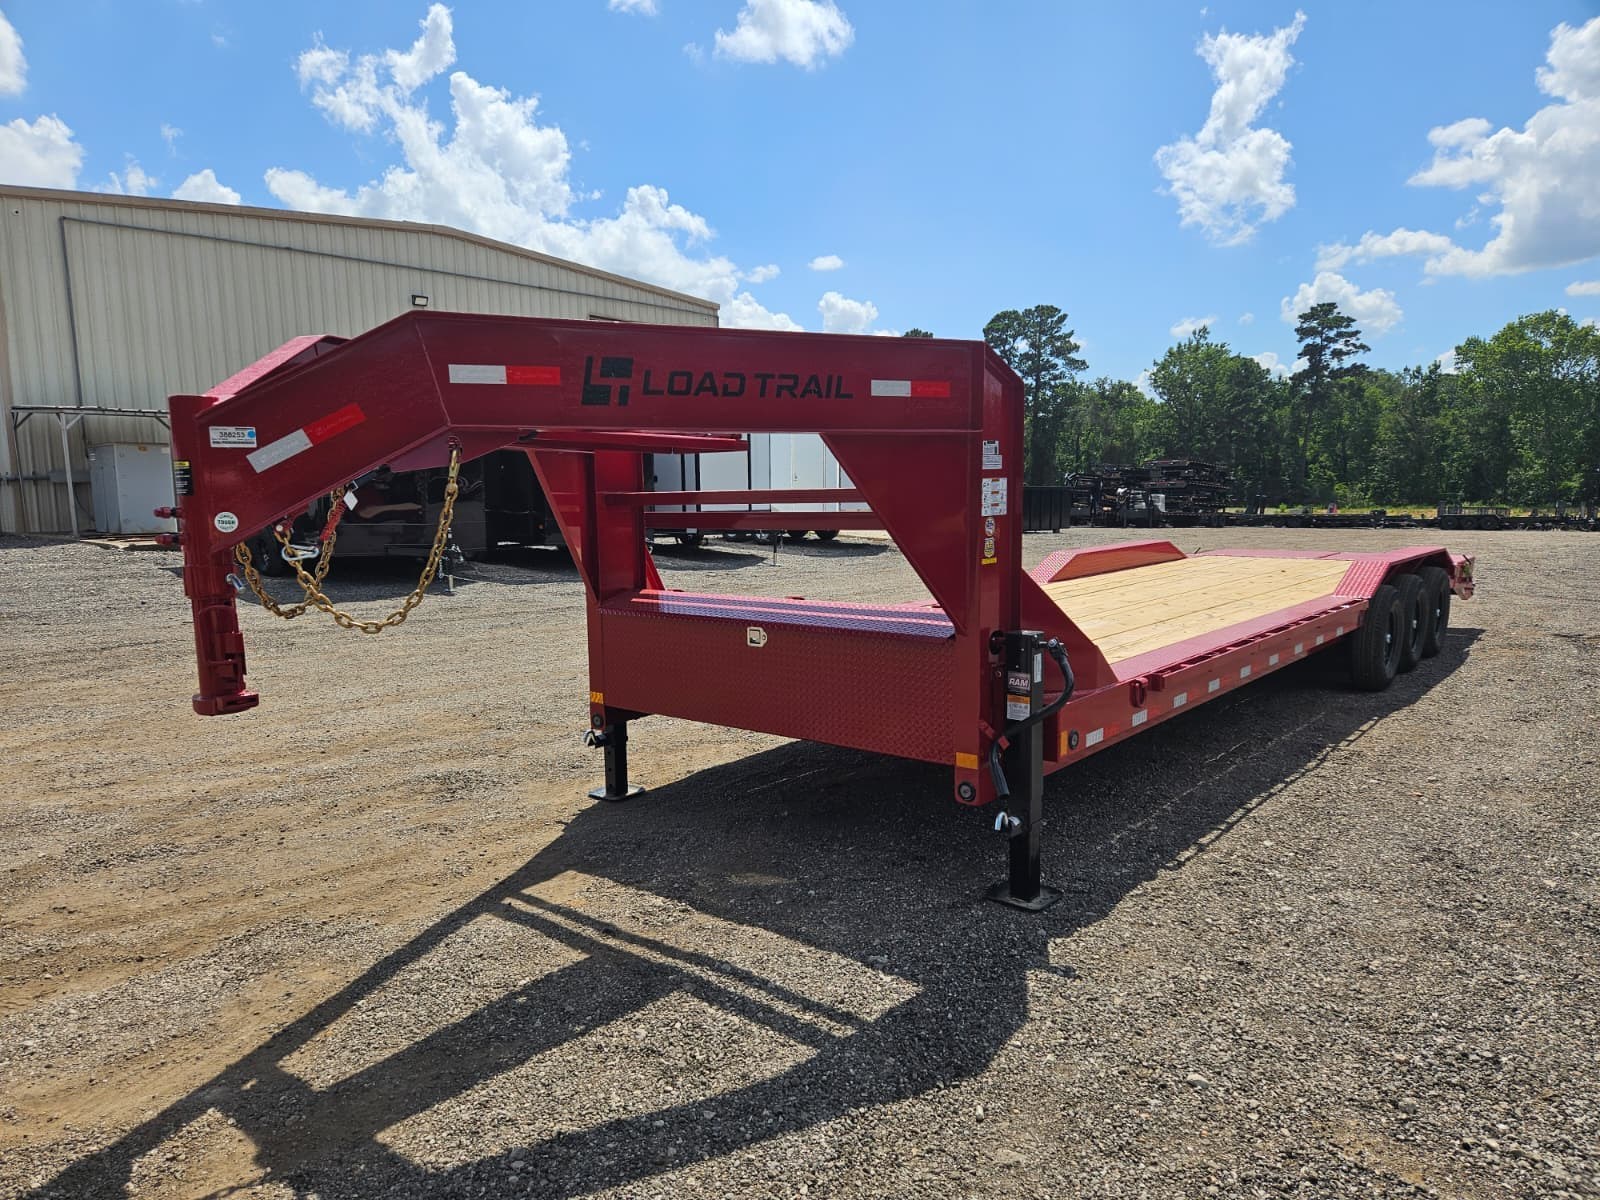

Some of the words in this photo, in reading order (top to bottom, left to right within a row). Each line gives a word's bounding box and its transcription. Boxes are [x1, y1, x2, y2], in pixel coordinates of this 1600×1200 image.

[643, 371, 747, 397] LOAD
[754, 373, 853, 399] TRAIL
[1009, 677, 1029, 687] RAM
